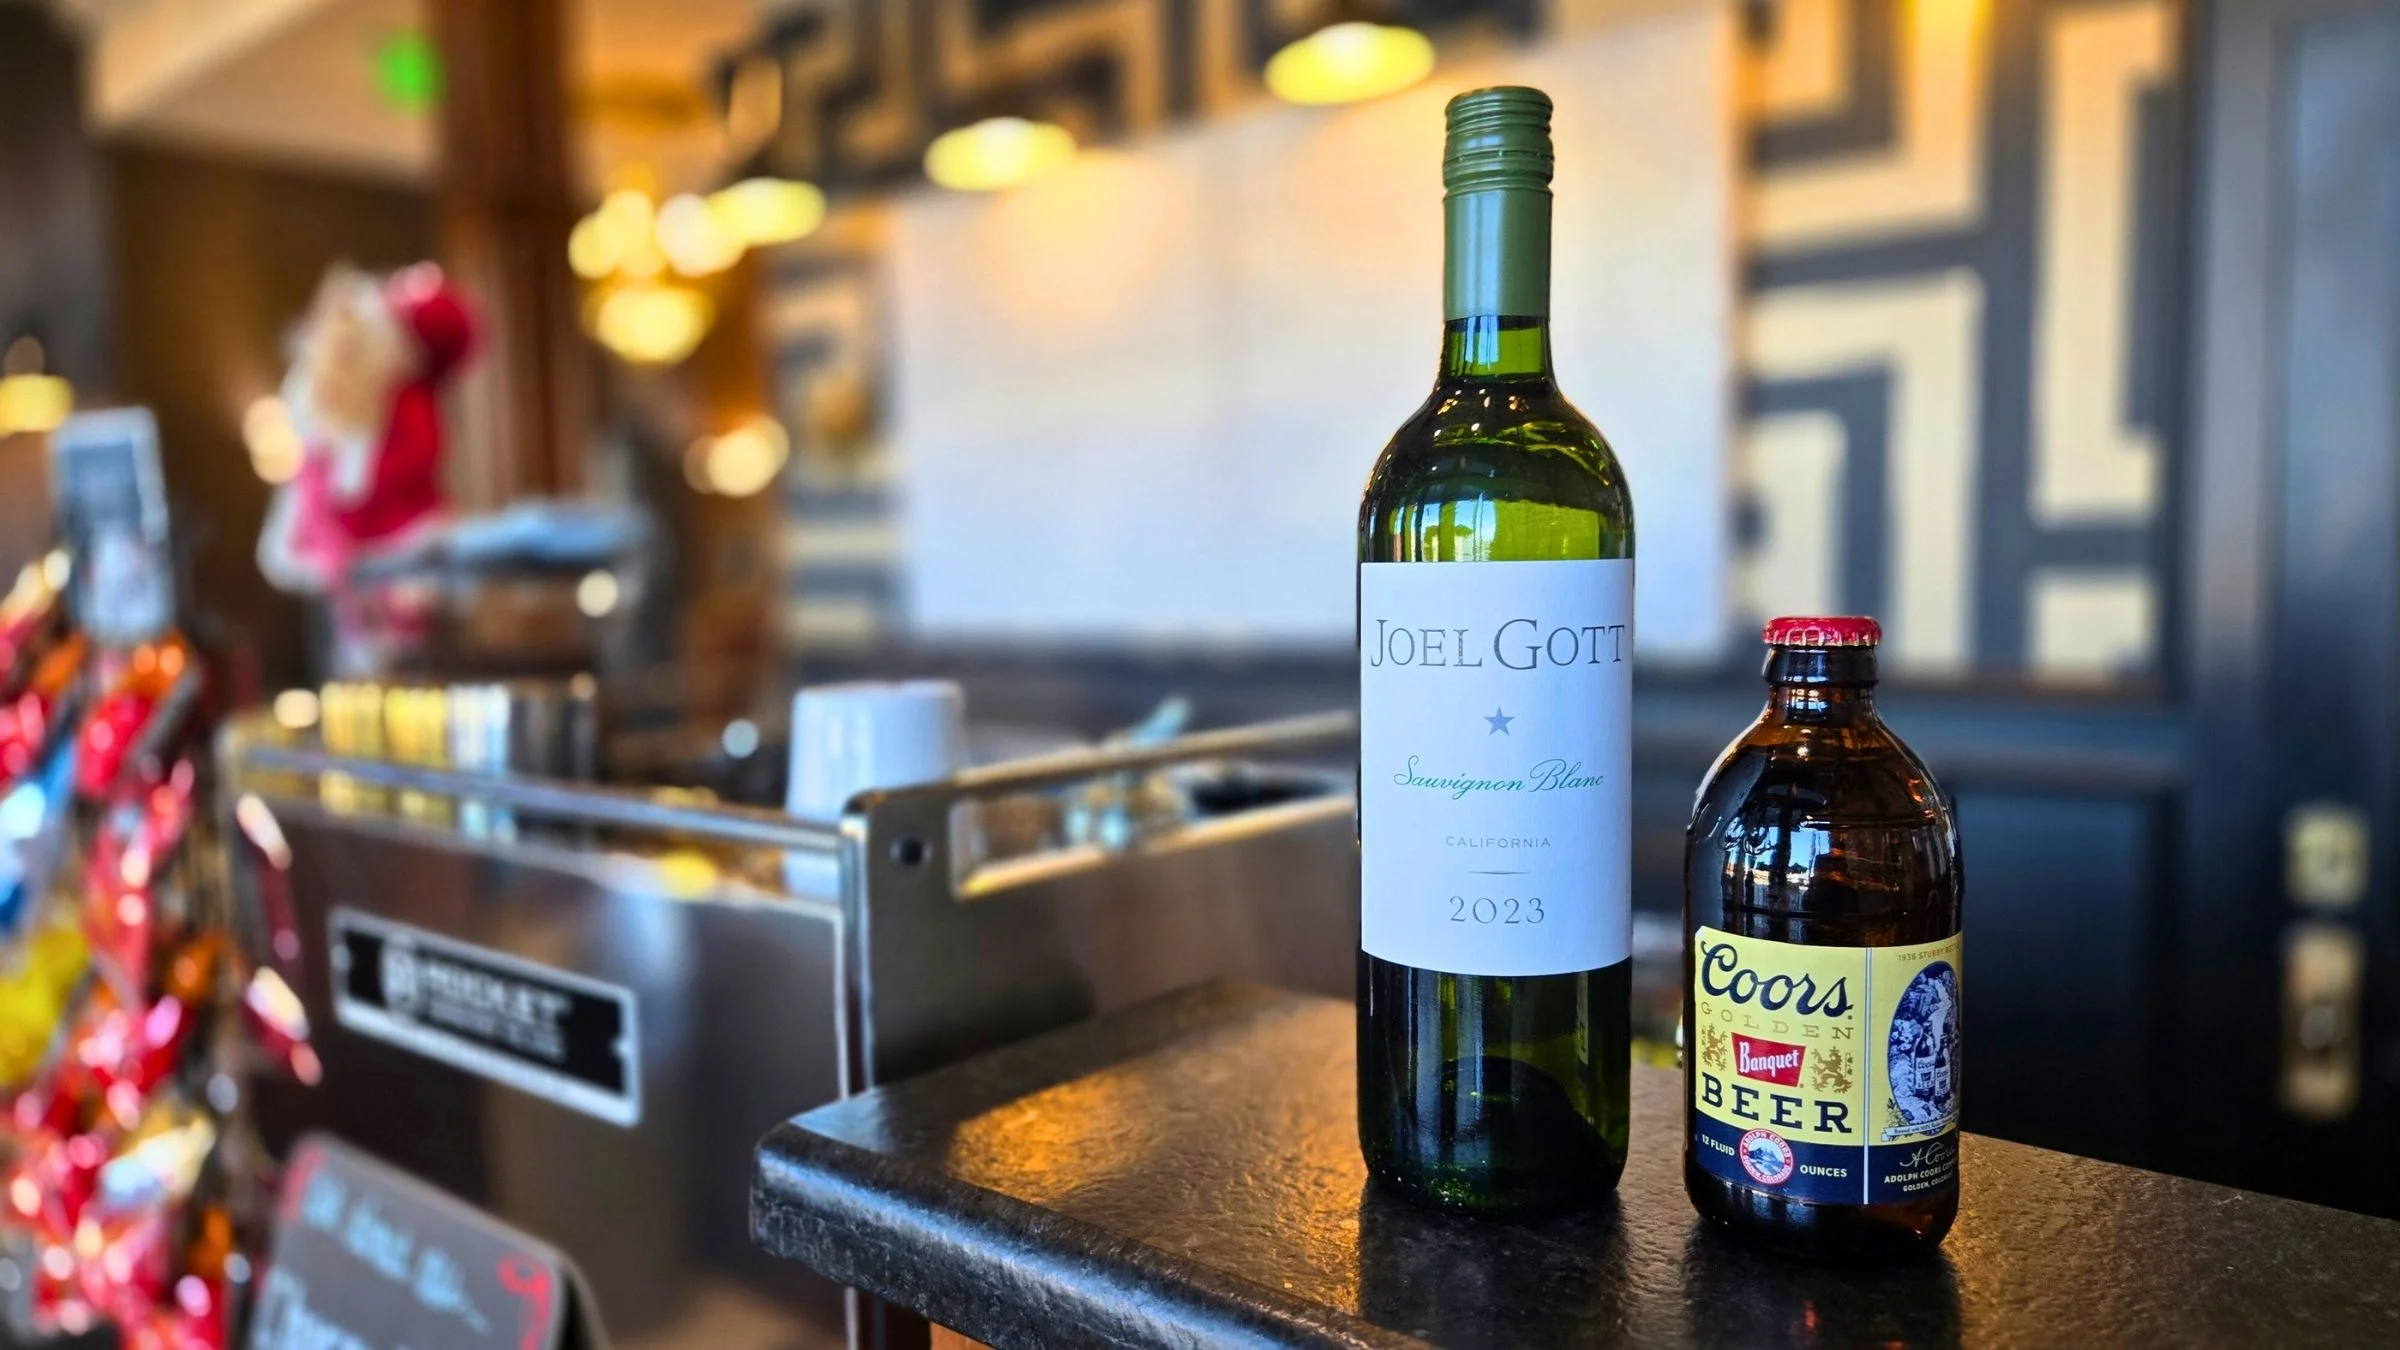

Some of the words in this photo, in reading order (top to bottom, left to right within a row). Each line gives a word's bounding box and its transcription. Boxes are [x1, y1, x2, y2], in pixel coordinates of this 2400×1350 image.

[1370, 618, 1483, 668] JOEL
[1493, 617, 1626, 670] GOTT
[1393, 755, 1526, 800] Sauvignon
[1528, 758, 1604, 793] Blanc
[1445, 836, 1551, 848] CALIFORNIA
[1449, 895, 1545, 924] 2023
[1700, 940, 1855, 1017] Coors
[1700, 1001, 1855, 1040] GOLDEN
[1738, 1041, 1800, 1078] Banquet
[1701, 1071, 1853, 1134] BEER
[1701, 1133, 1709, 1146] 12
[1710, 1138, 1736, 1156] FLUID
[1800, 1164, 1848, 1178] OUNCES
[1884, 1172, 1919, 1184] ADOLPH
